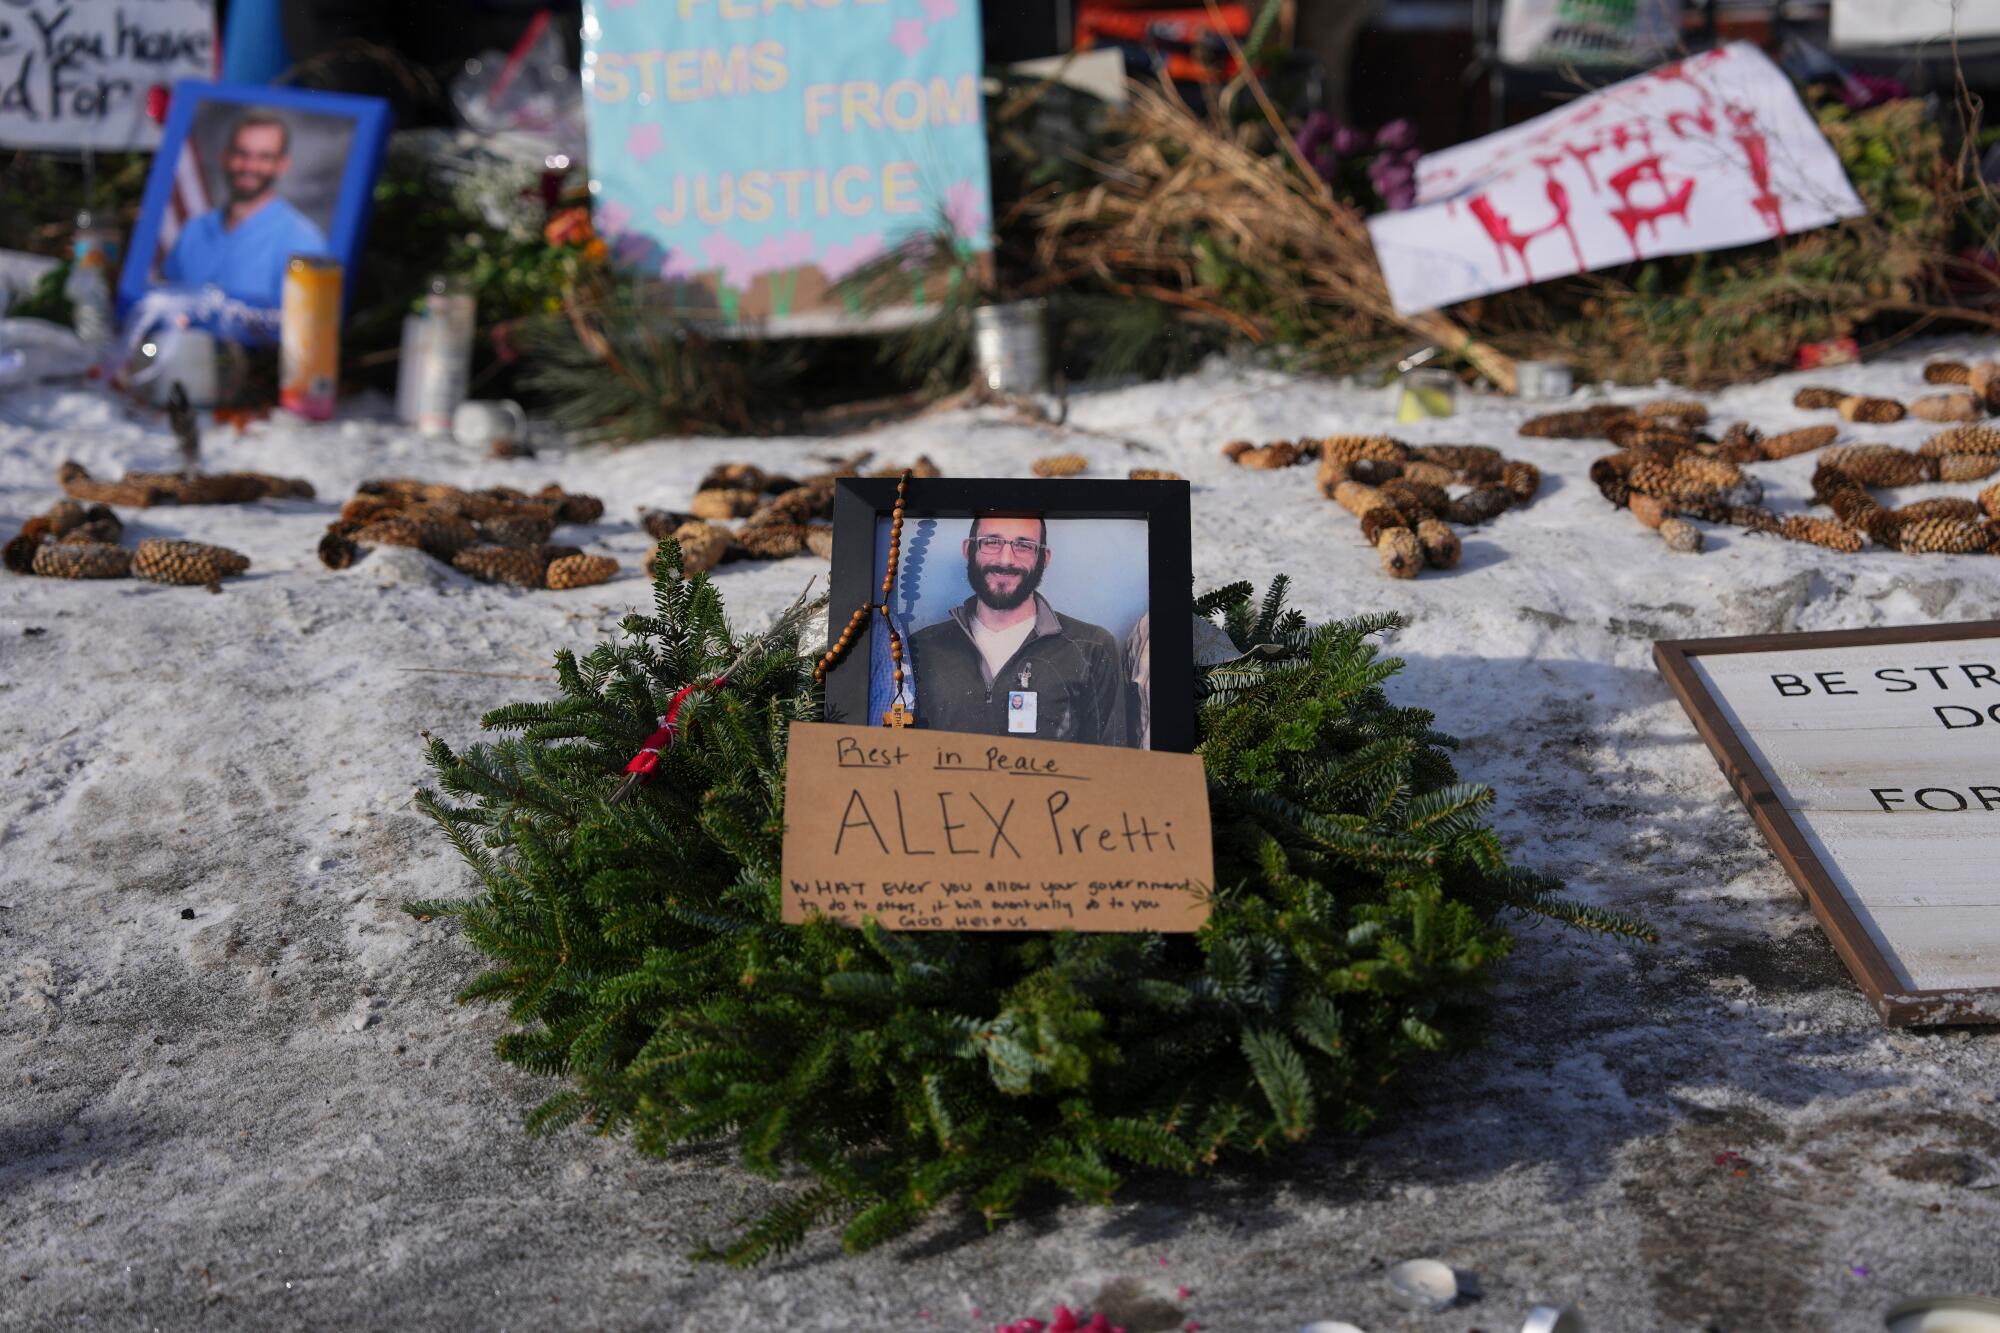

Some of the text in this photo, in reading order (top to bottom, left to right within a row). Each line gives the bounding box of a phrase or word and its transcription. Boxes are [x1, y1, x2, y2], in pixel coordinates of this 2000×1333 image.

[28, 6, 108, 63] You
[114, 6, 210, 67] have
[591, 41, 789, 104] STEMS
[804, 74, 979, 136] FROM
[656, 161, 922, 226] JUSTICE
[1770, 664, 2000, 697] BE STR
[1933, 703, 2000, 729] D
[837, 737, 909, 765] Rest
[936, 747, 962, 766] in
[1869, 786, 2000, 813] FOR
[834, 789, 1176, 859] ALEX Pretti
[791, 880, 866, 896] WHAT
[940, 882, 973, 897] you
[985, 880, 1030, 891] allow
[1041, 881, 1079, 898] your
[829, 898, 846, 911] do
[853, 899, 867, 911] to
[933, 899, 948, 912] it
[1109, 897, 1124, 909] to
[1131, 900, 1160, 912] you
